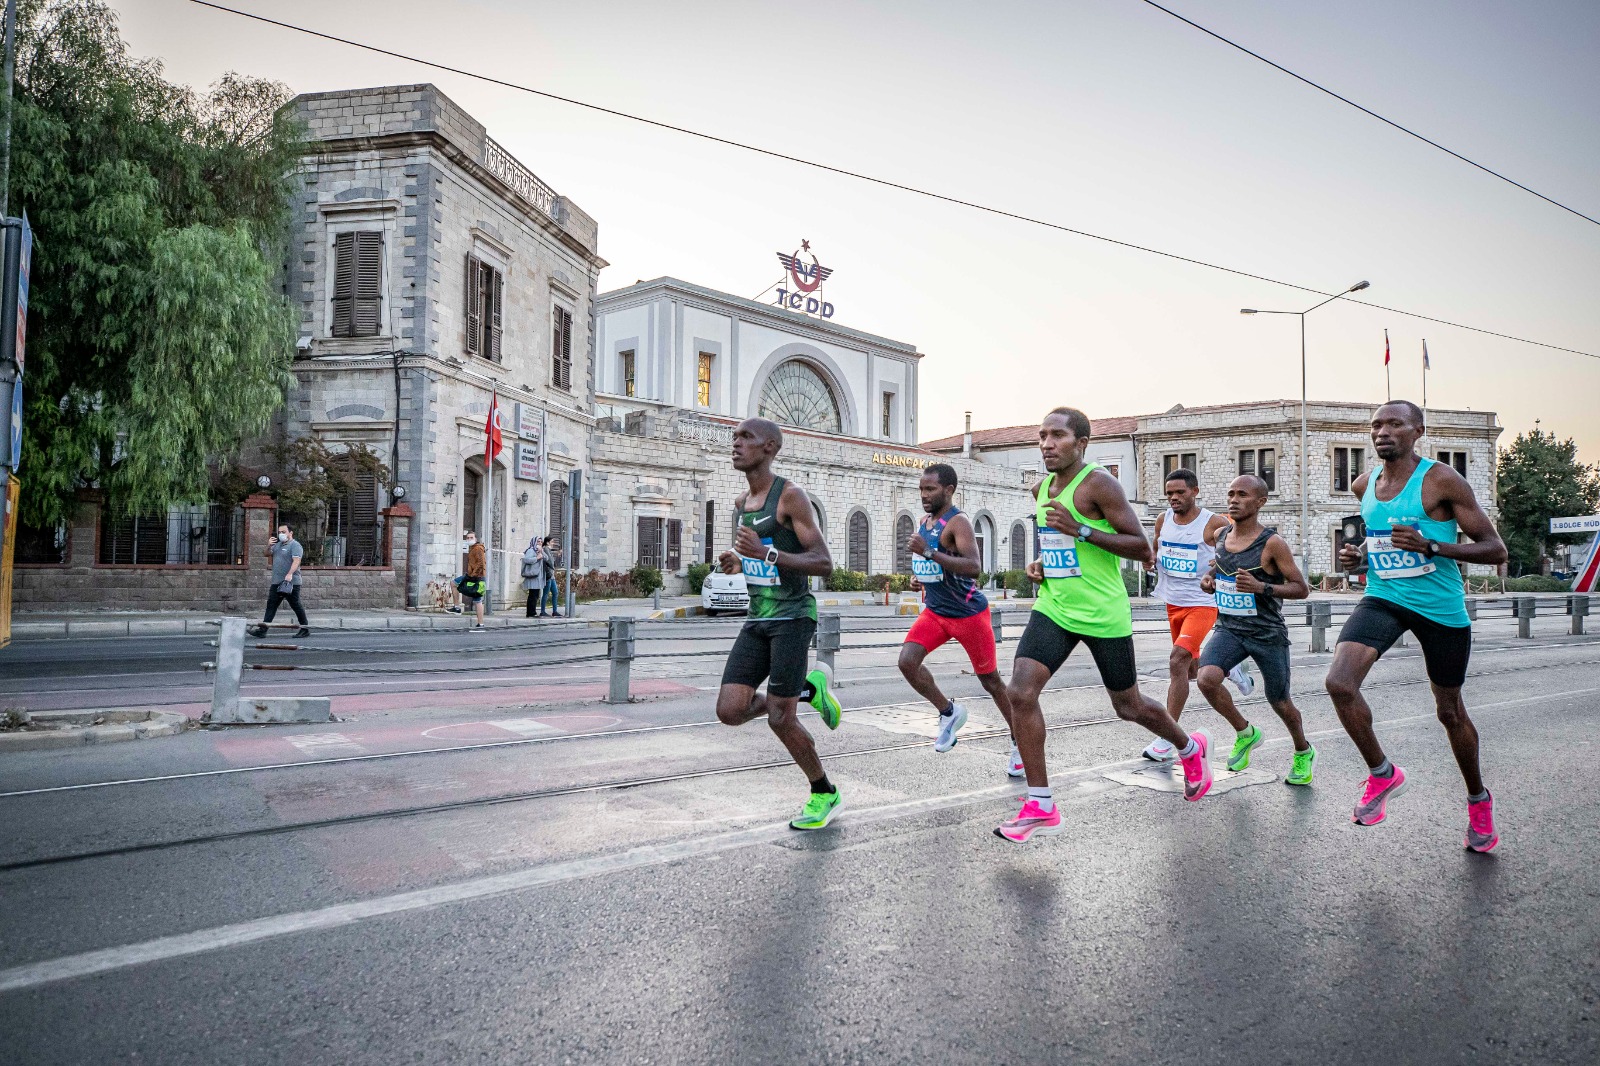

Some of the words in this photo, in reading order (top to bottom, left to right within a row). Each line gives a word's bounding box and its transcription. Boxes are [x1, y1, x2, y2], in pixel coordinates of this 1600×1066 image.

[776, 288, 834, 318] TCDD
[872, 452, 926, 469] ALSANCAK
[1162, 556, 1196, 572] 10289
[1215, 592, 1254, 608] 10358
